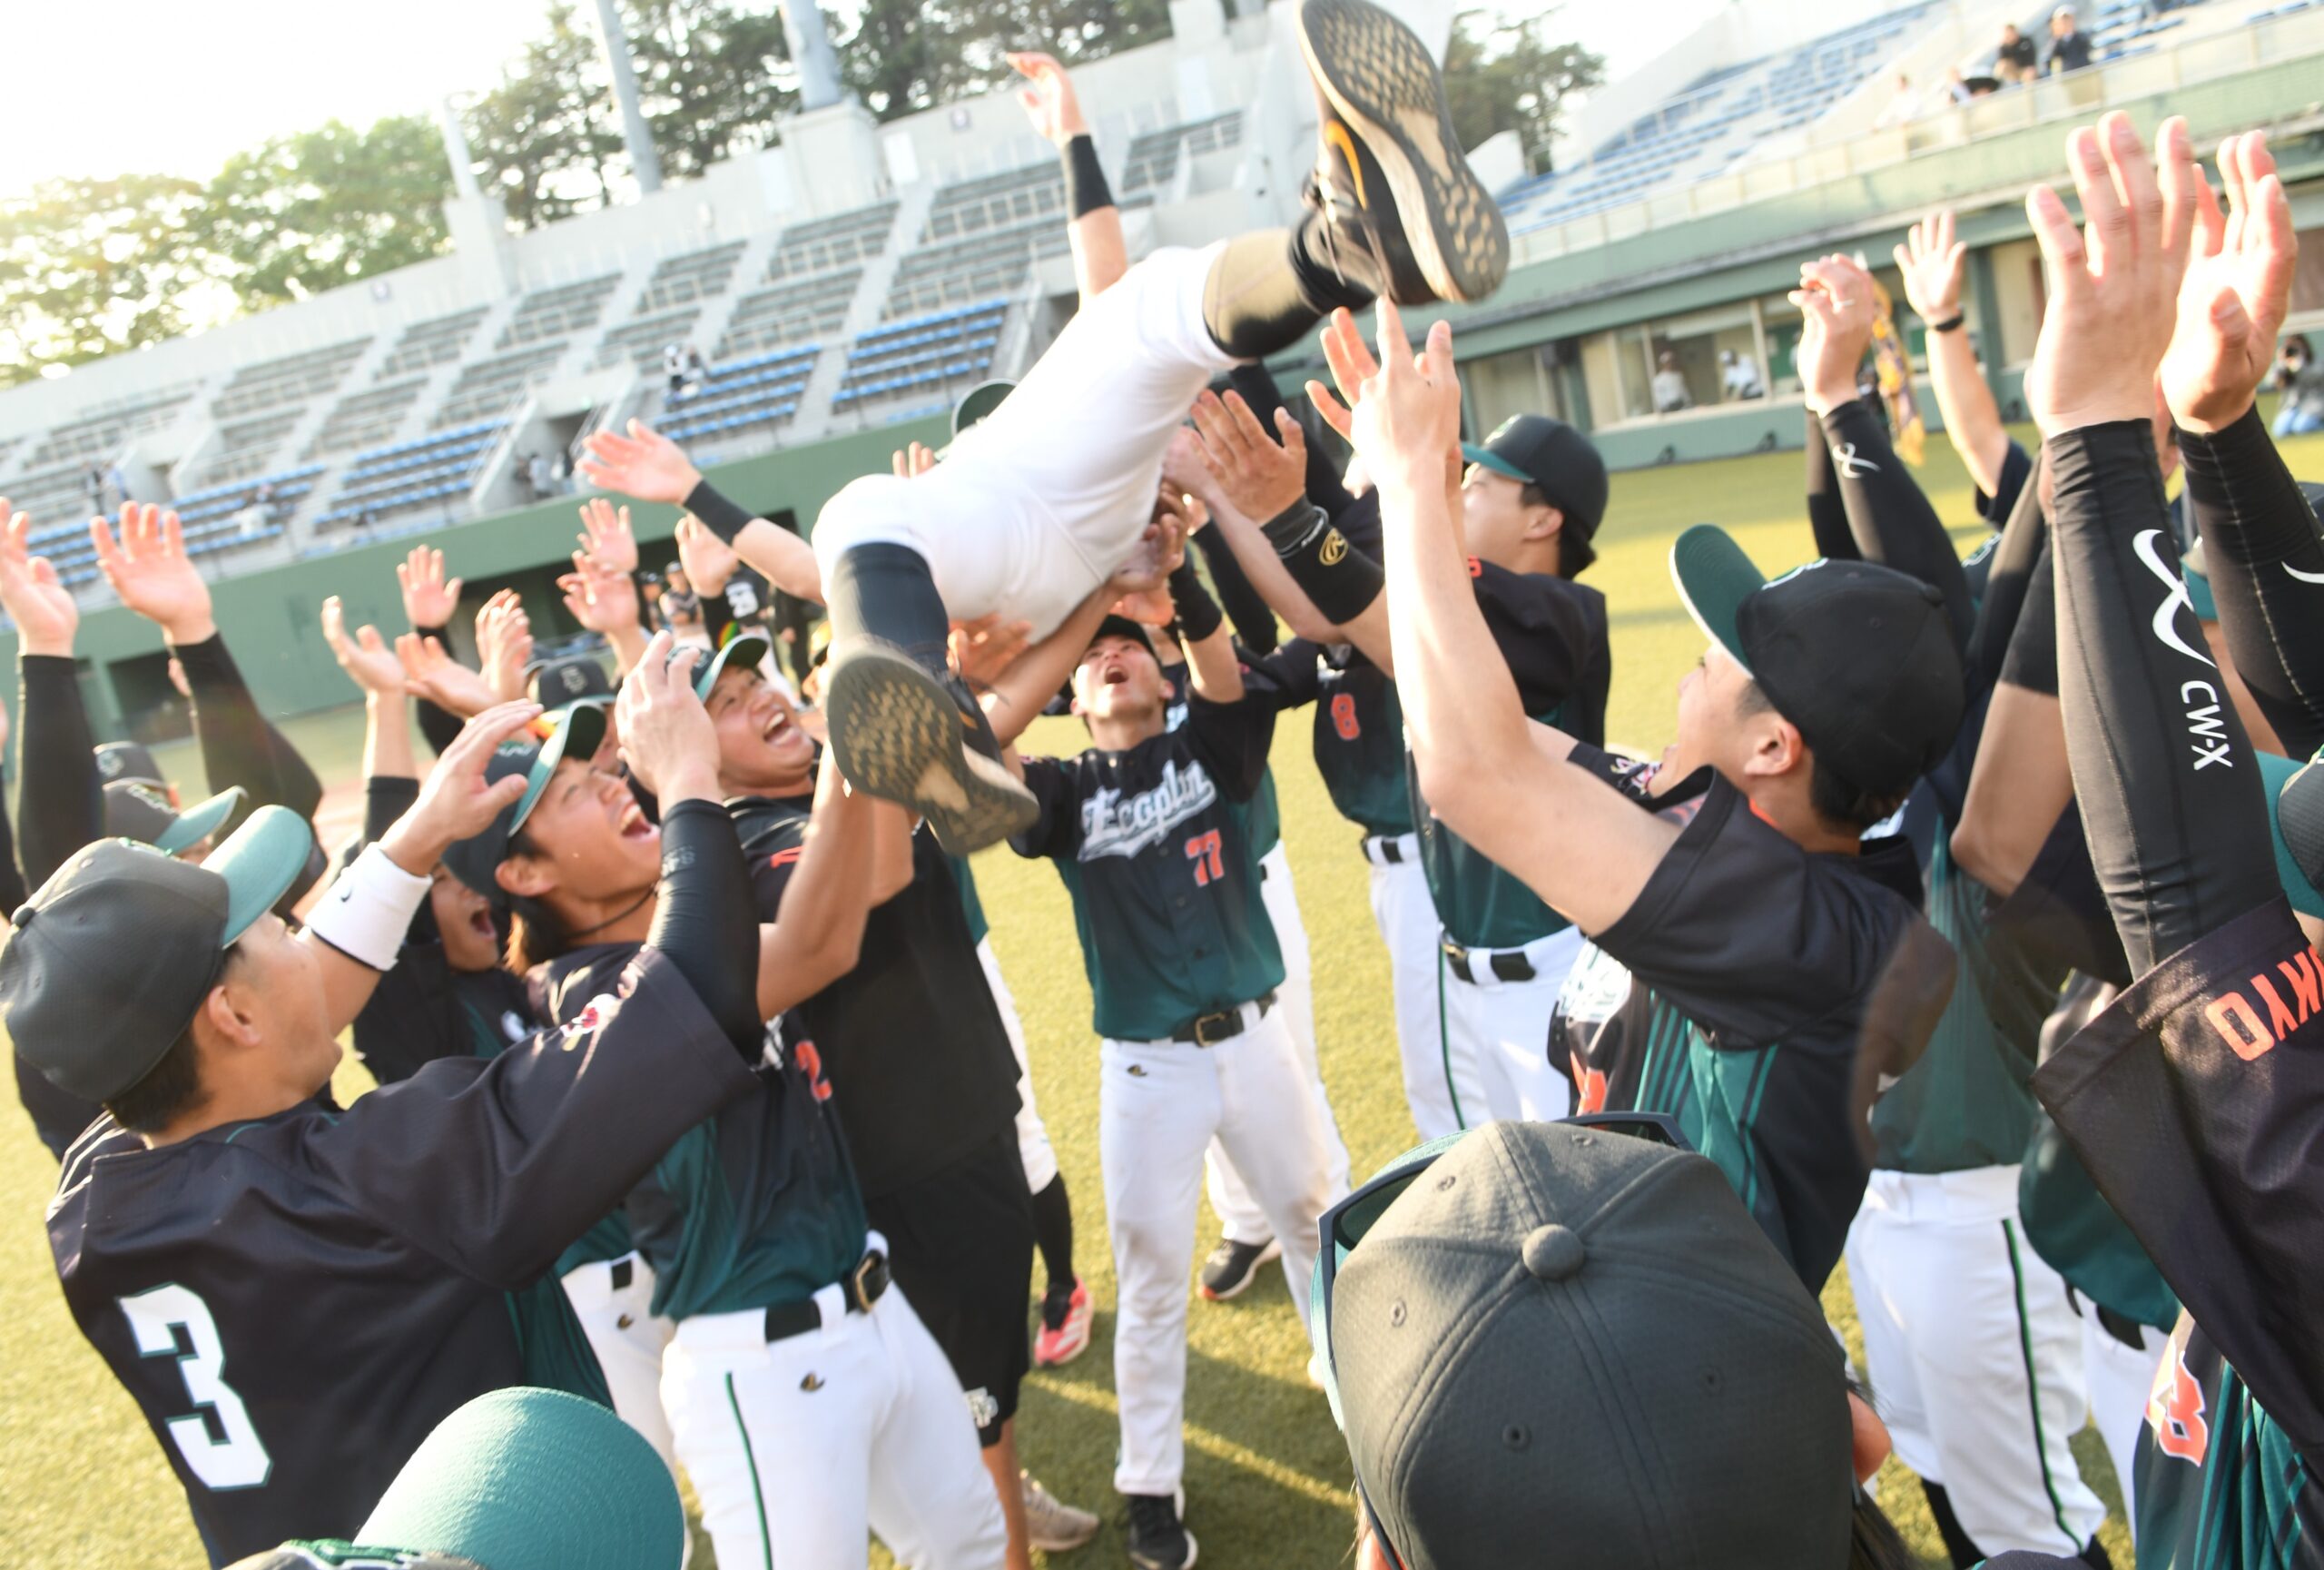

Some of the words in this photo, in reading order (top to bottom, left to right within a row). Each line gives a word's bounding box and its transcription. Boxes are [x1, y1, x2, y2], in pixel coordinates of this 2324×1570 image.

[1331, 693, 1361, 741] 8
[2181, 680, 2233, 771] CW-X
[1185, 828, 1225, 887] 77
[2204, 944, 2324, 1061] KYO
[795, 1039, 833, 1103] 2
[114, 1281, 274, 1492] 3
